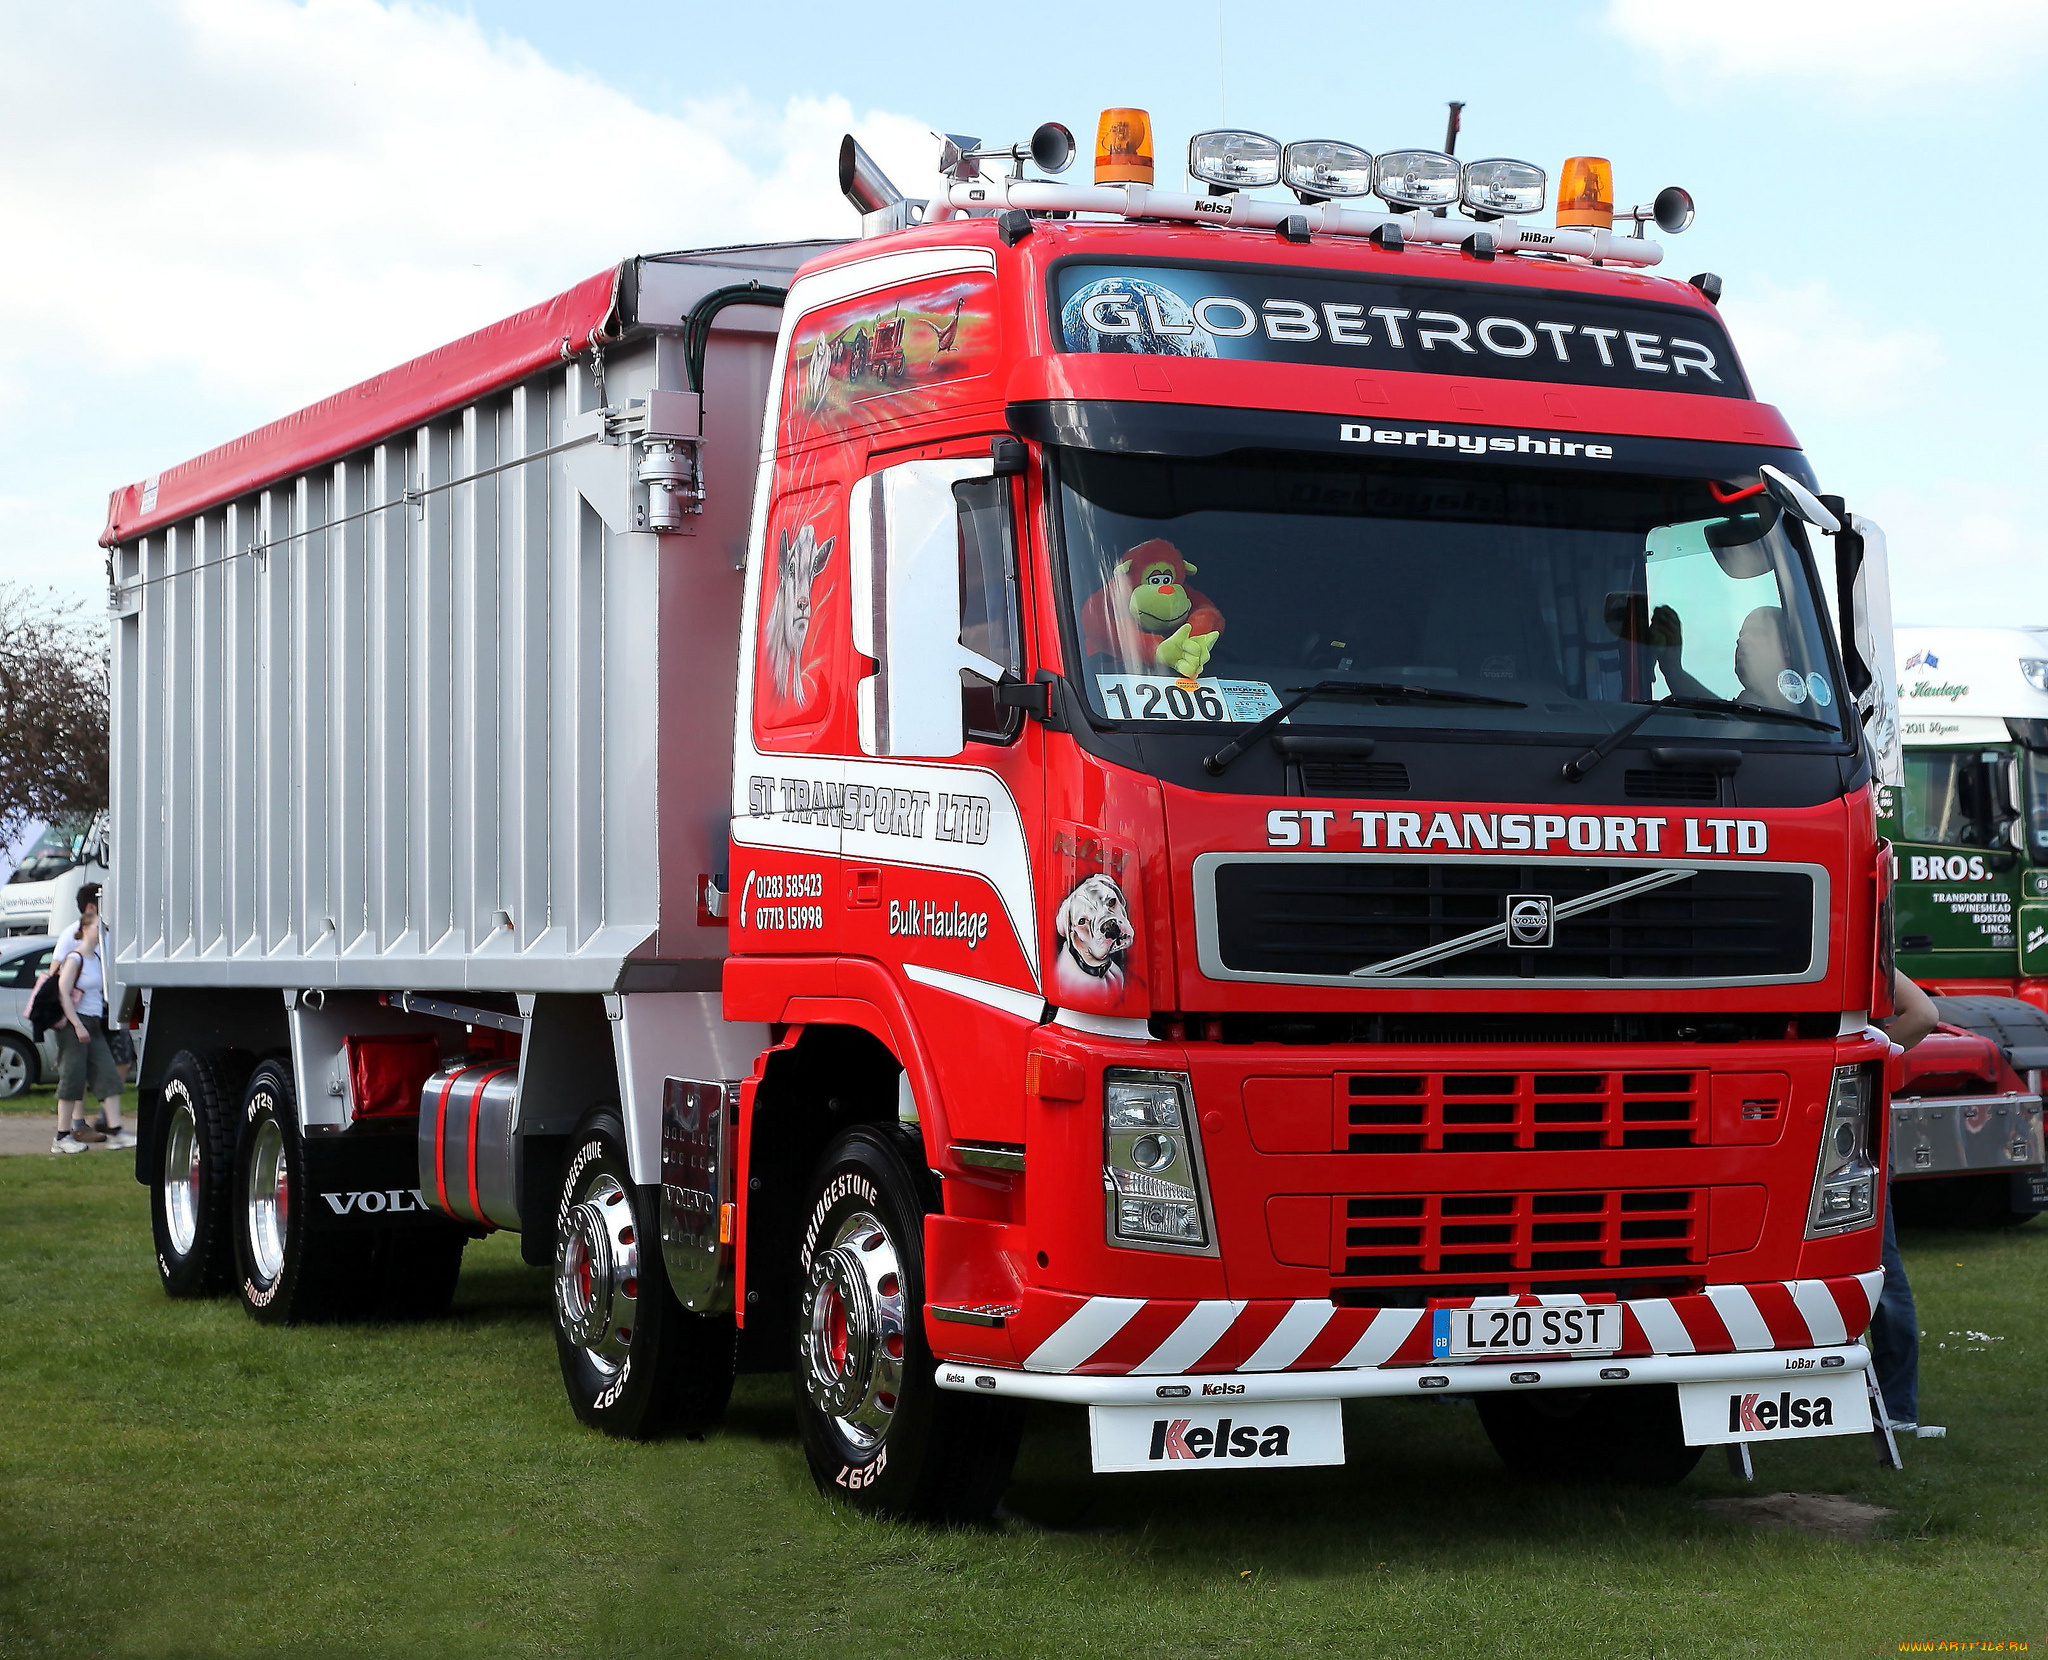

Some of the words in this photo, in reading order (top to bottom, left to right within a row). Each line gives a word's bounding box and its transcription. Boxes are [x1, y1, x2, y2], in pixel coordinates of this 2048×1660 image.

[1194, 200, 1232, 214] Kelsa
[1520, 231, 1555, 244] HiBar
[1080, 292, 1723, 384] GLOBETROTTER
[1339, 423, 1613, 460] Derbyshire
[1106, 683, 1224, 721] 1206
[748, 775, 776, 819] ST
[781, 778, 930, 839] TRANSPORT
[935, 793, 992, 845] LTD
[1266, 809, 1335, 847] ST
[1352, 811, 1669, 853] TRANSPORT
[1684, 817, 1769, 855] LTD
[1911, 855, 1994, 881] BROS.
[756, 874, 783, 899] 01283
[785, 873, 822, 897] 585423
[1933, 893, 1988, 902] TRANSPORT
[756, 906, 785, 930] 07713
[786, 905, 823, 930] 151998
[1951, 904, 2011, 913] SWINESHEAD
[1973, 914, 2011, 923] BOSTON
[889, 899, 922, 936] Bulk
[923, 901, 988, 949] Haulage
[320, 1189, 430, 1215] VOLV
[663, 1183, 714, 1214] VOLVO
[801, 1174, 878, 1275] BRIDGESTONE
[1436, 1338, 1447, 1347] GB
[1467, 1311, 1531, 1348] L20
[1542, 1309, 1605, 1345] SST
[1785, 1357, 1815, 1370] LoBar
[594, 1354, 632, 1409] R297
[946, 1372, 965, 1384] Kelsa
[1201, 1381, 1245, 1396] Kelsa
[1728, 1392, 1834, 1432] Kelsa
[1149, 1418, 1290, 1460] Kelsa
[836, 1444, 888, 1489] R297
